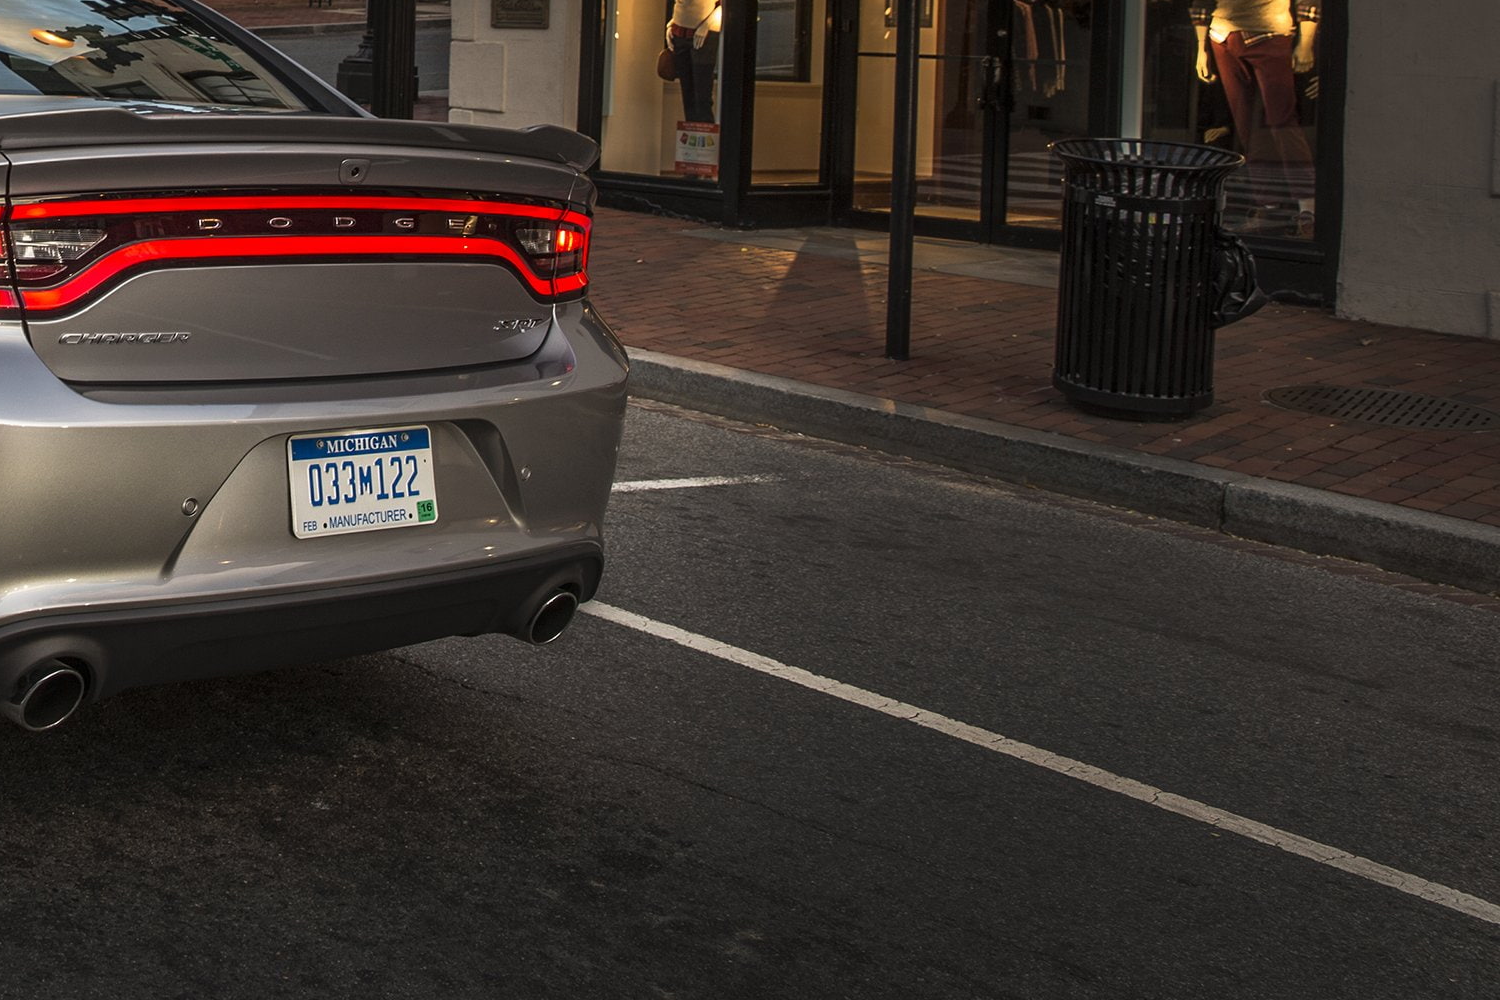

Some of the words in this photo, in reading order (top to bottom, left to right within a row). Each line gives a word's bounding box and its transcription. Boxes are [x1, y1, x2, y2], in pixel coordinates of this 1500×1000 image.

[197, 215, 468, 233] DODGE
[58, 332, 192, 345] CHARGER
[326, 434, 398, 454] MICHIGAN
[308, 455, 420, 507] 033M122
[420, 502, 433, 512] 16
[303, 520, 318, 532] FEB
[329, 508, 407, 529] MANUFACTURER
